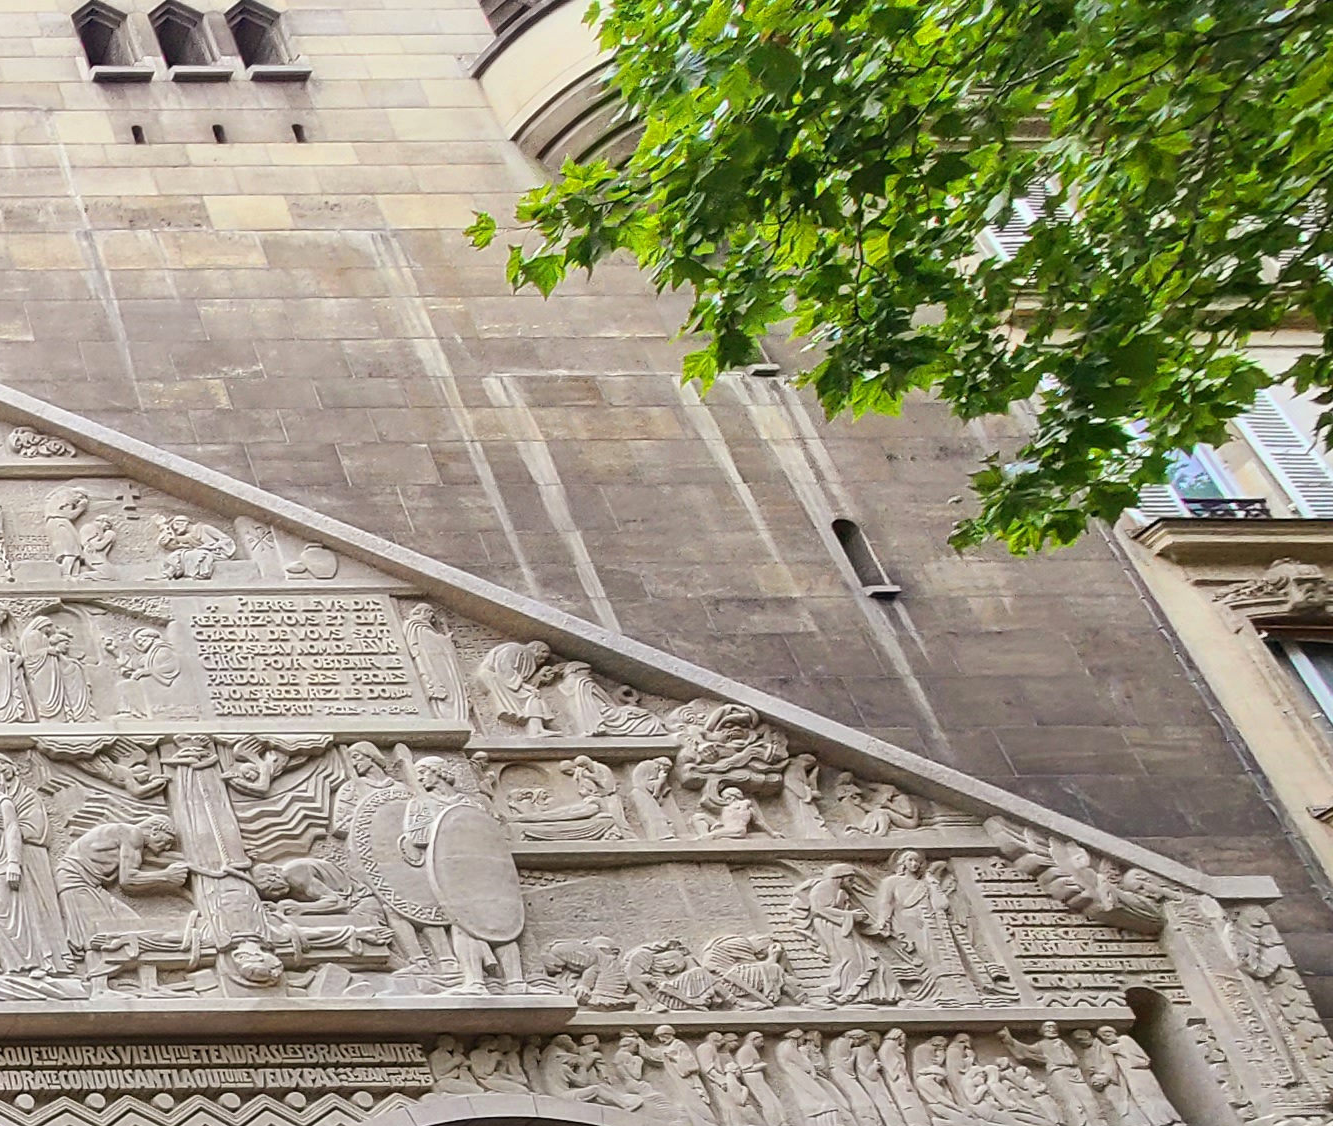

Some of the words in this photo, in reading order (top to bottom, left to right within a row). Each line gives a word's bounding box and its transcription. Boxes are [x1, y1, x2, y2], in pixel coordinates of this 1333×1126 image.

[237, 598, 298, 612] PIERRE
[324, 613, 346, 626] ET
[267, 628, 291, 641] DE
[277, 672, 300, 686] DE
[56, 1046, 121, 1066] AURAS
[189, 1045, 284, 1064] ETENDRAS
[303, 1044, 350, 1063] BRAS
[374, 1043, 428, 1063] AUTRE
[59, 1069, 177, 1090] CONDUISANT
[253, 1068, 304, 1088] VEUX
[303, 1068, 337, 1087] PAS
